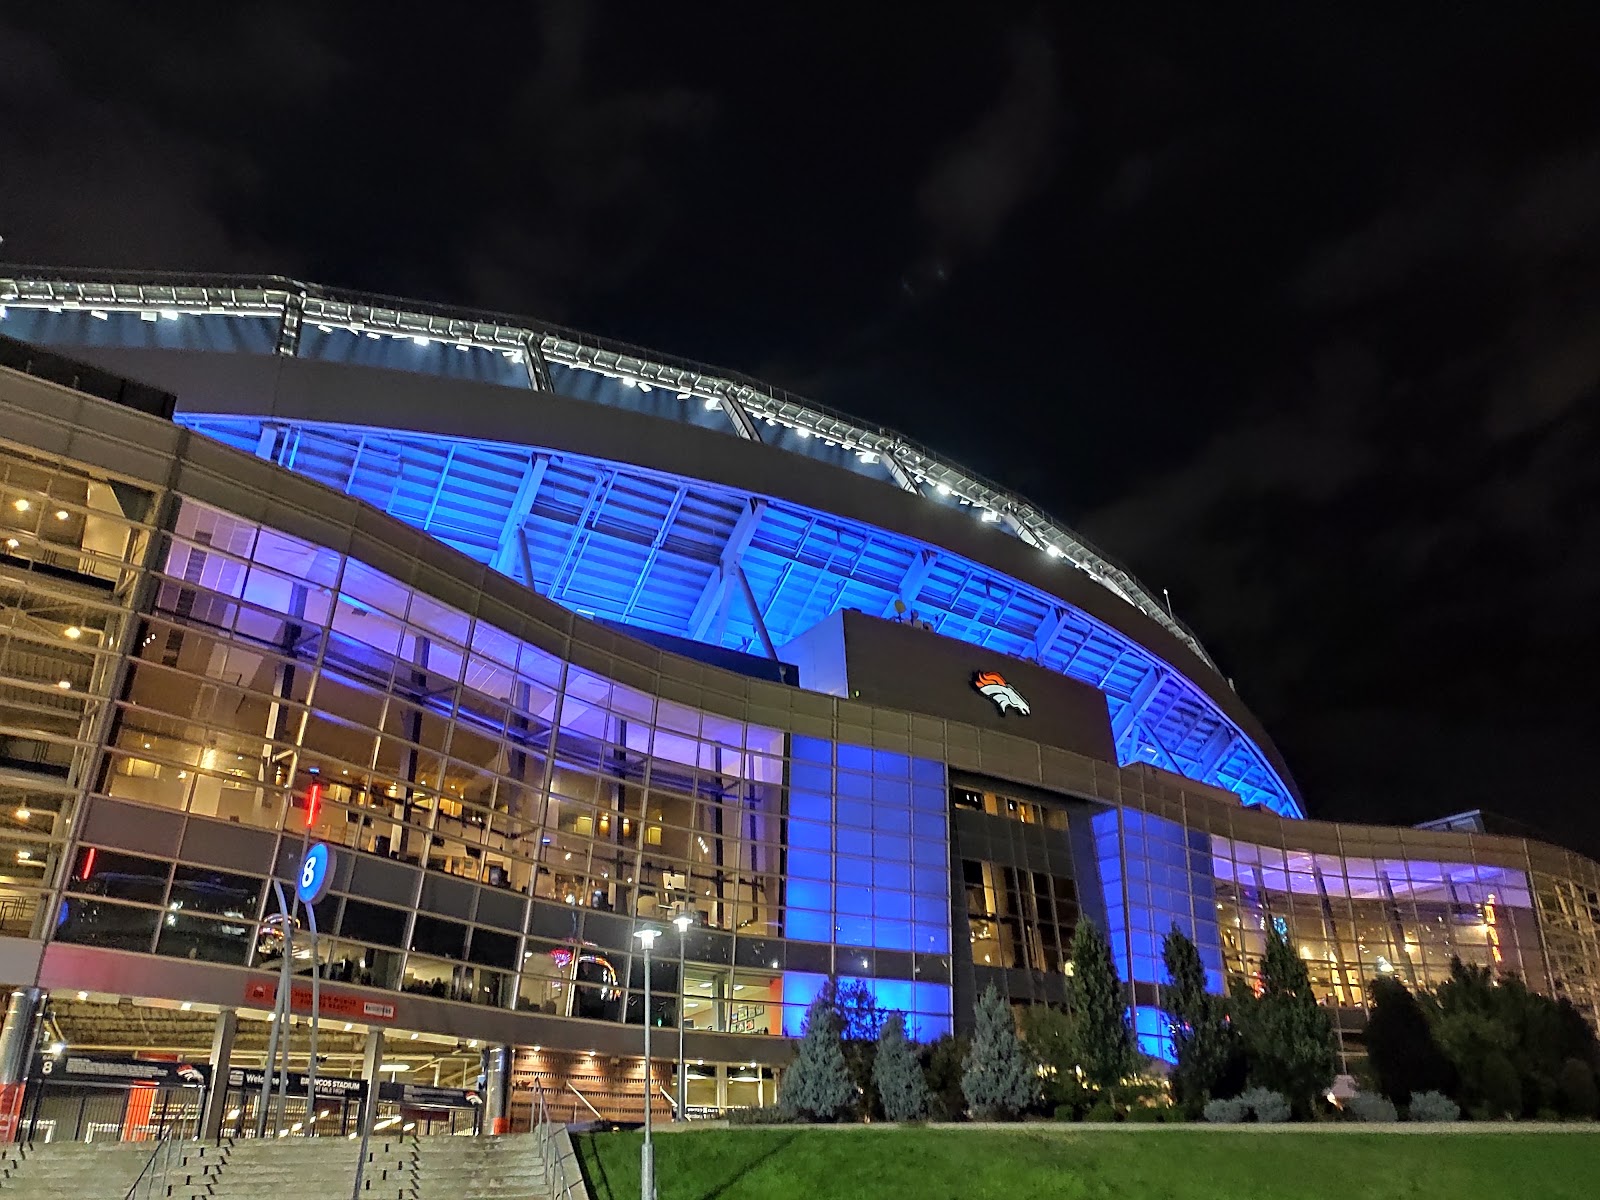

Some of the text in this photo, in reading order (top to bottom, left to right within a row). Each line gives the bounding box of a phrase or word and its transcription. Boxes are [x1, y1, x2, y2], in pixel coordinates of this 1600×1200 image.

[302, 856, 317, 888] 8
[42, 1061, 53, 1075] 8
[246, 1073, 279, 1085] Welcme
[300, 1076, 360, 1090] BRNCOS STADIUM
